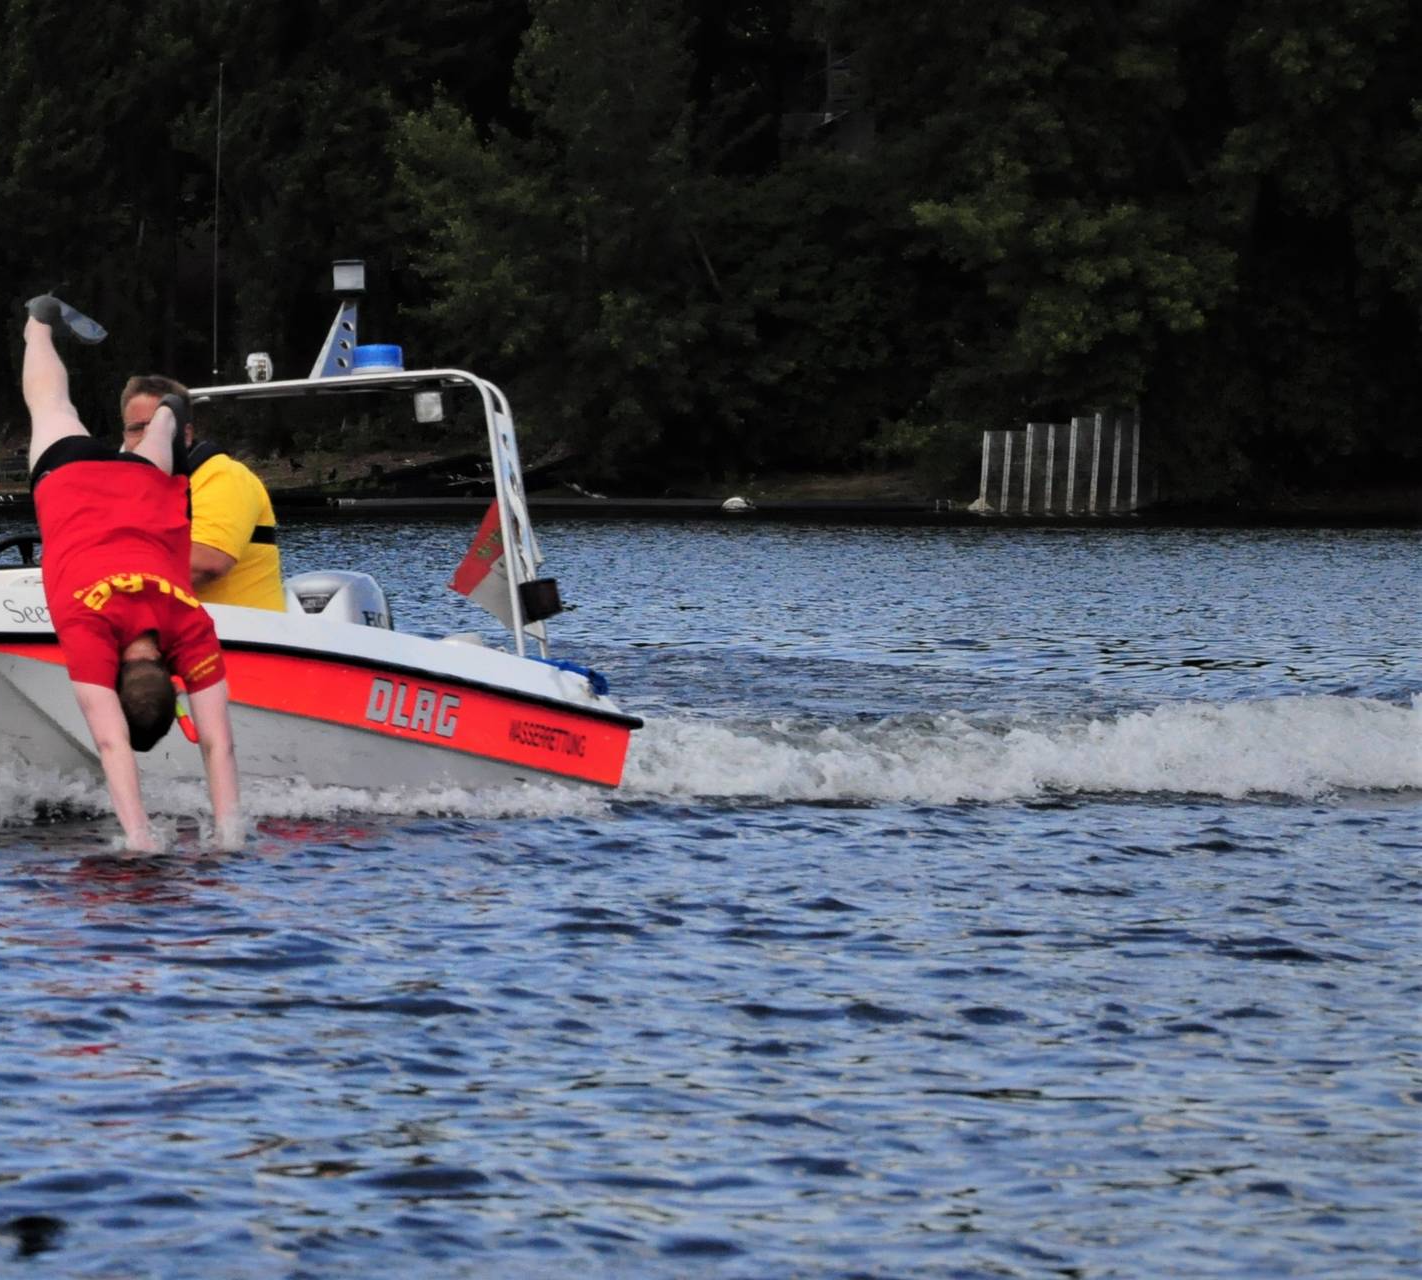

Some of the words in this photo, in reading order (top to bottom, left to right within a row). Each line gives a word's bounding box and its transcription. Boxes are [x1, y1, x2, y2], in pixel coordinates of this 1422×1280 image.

[2, 599, 50, 624] See
[366, 677, 462, 739] DLRG
[509, 720, 587, 758] WASSERRETTUNG
